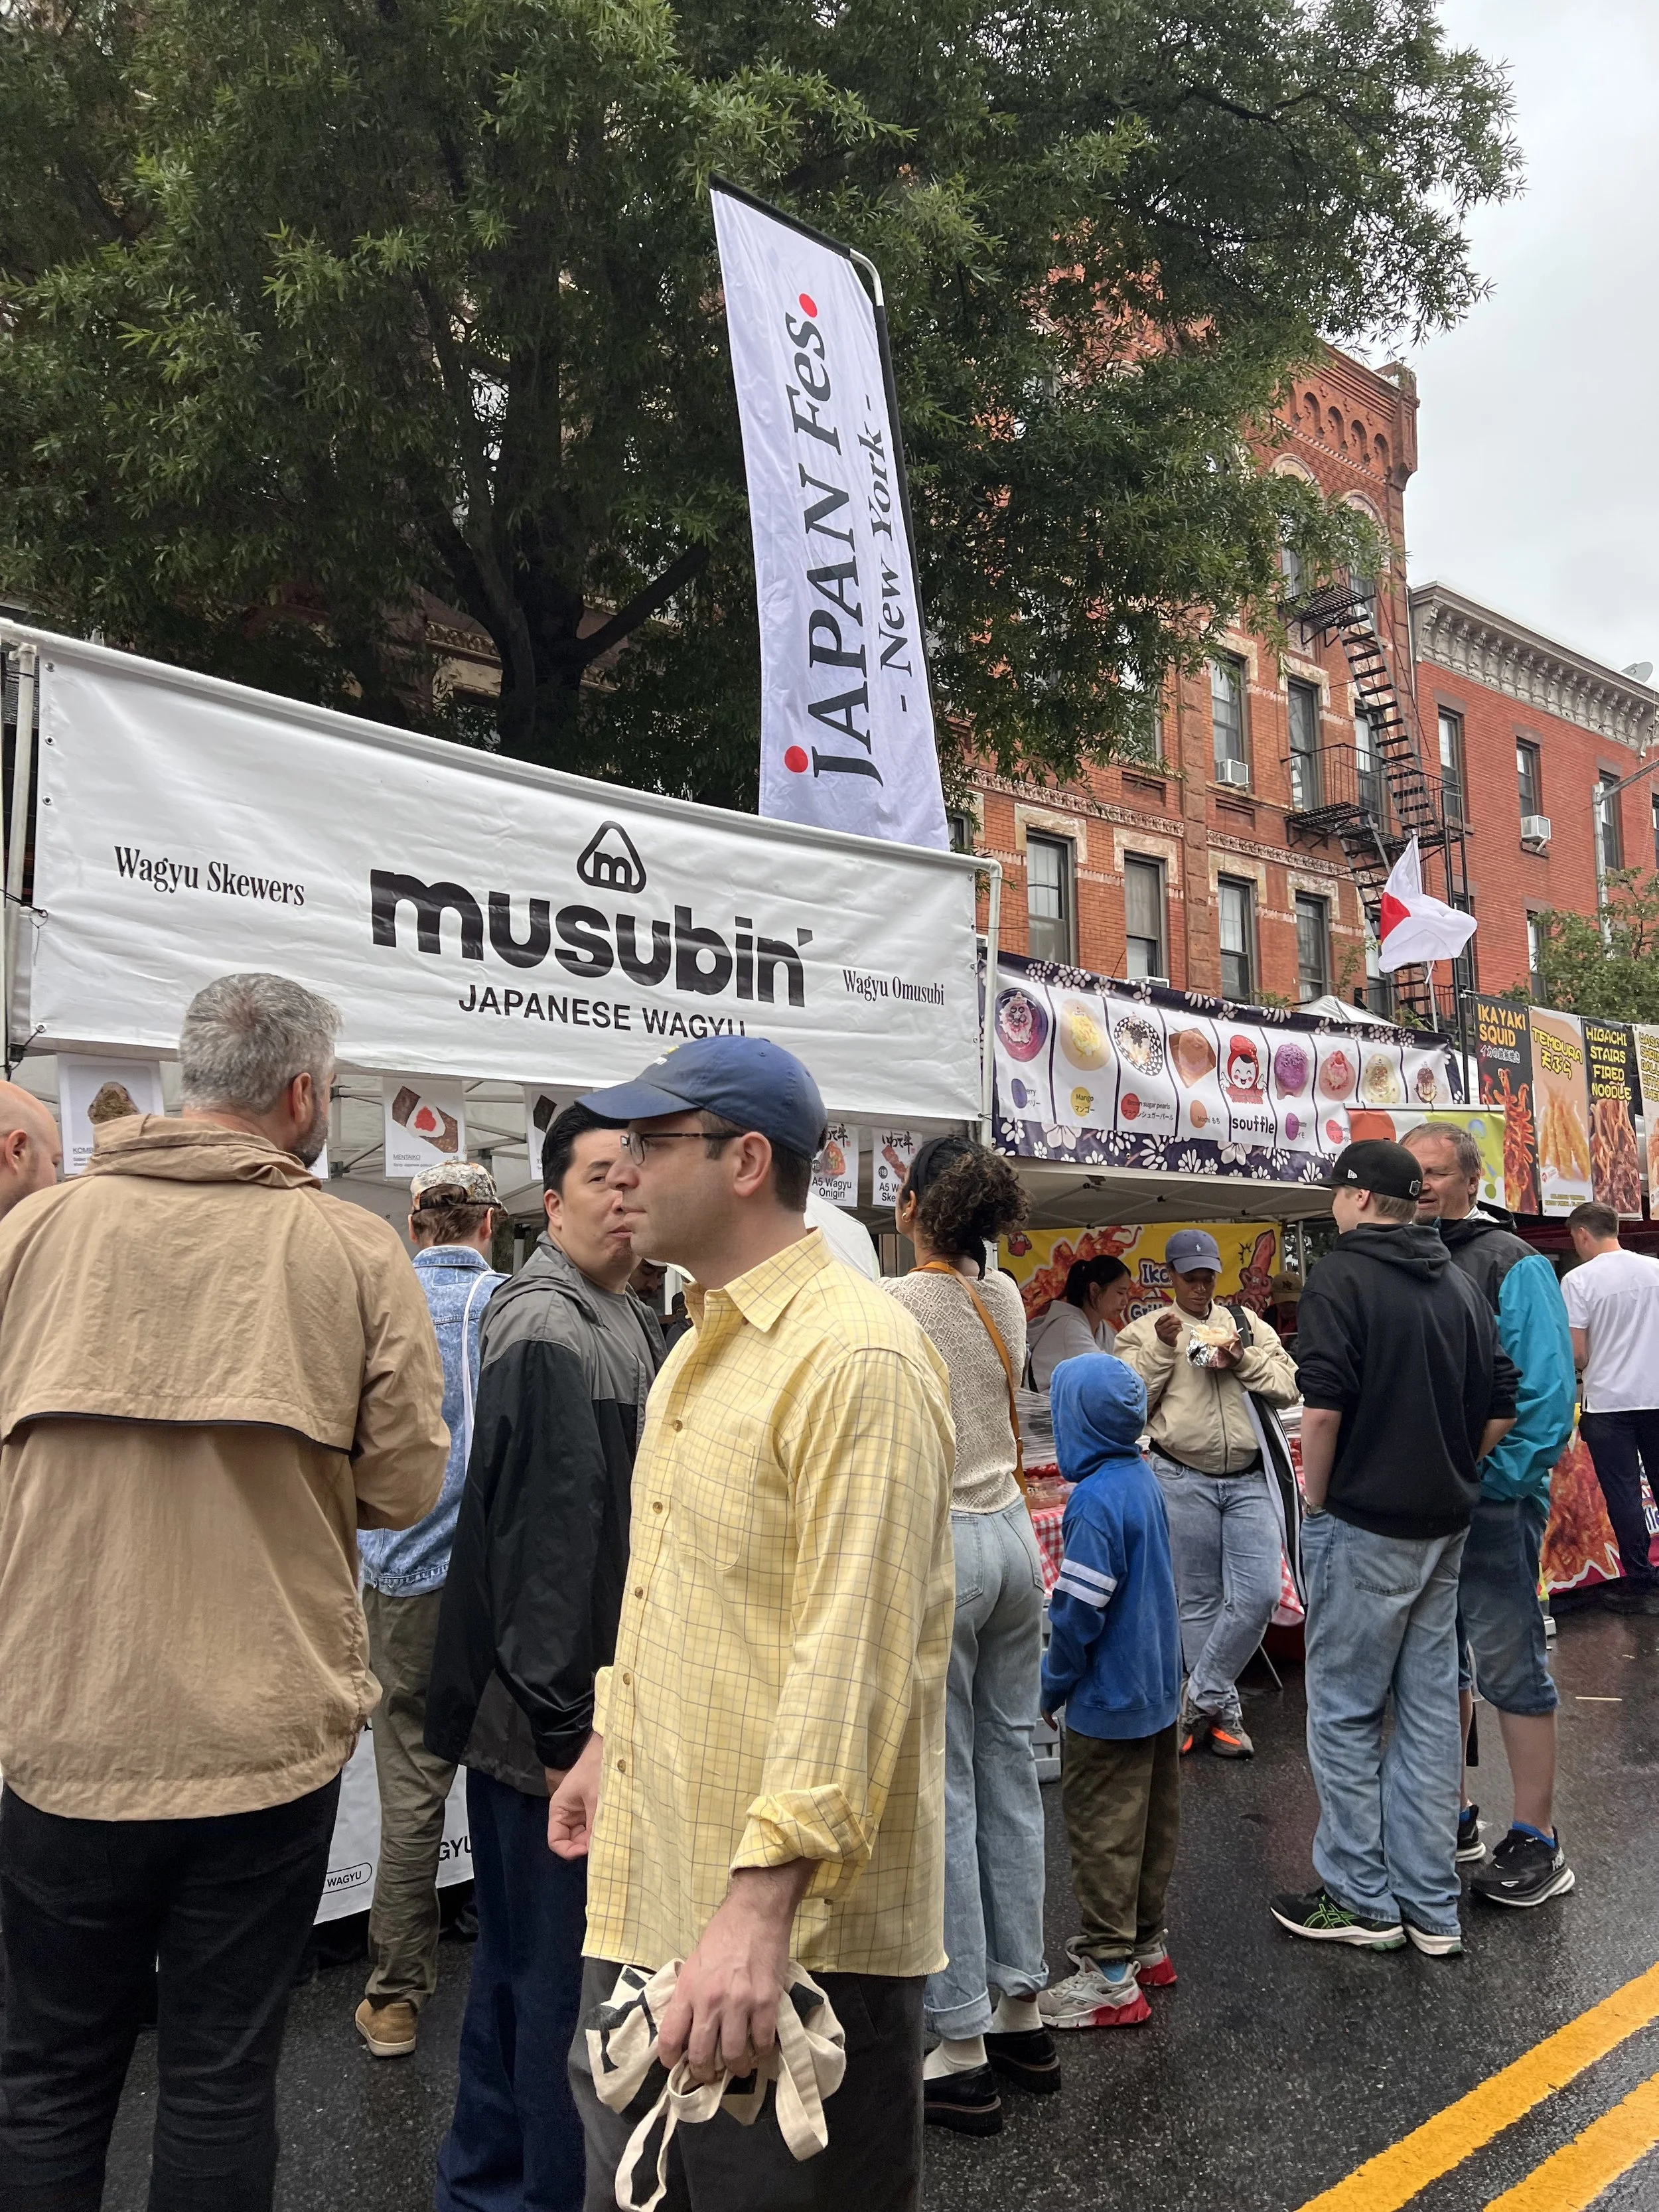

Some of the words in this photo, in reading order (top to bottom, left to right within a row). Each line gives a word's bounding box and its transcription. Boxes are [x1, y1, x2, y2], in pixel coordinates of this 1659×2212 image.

[784, 292, 843, 456] Fes.
[857, 421, 893, 542] York
[878, 552, 913, 678] New
[113, 846, 199, 893] Wagyu
[206, 861, 305, 907] Skewers
[842, 969, 889, 1004] Wagyu
[893, 974, 946, 1006] Omusubi
[459, 984, 632, 1031] JAPANESE
[642, 1007, 745, 1039] WAGYU
[1477, 1003, 1526, 1031] IKAYAKI
[1479, 1023, 1516, 1047] SQUID
[1585, 1026, 1628, 1047] HIBACHI
[1638, 1031, 1659, 1049] WASA
[1541, 1047, 1573, 1080] 天ぷら
[1590, 1045, 1626, 1064] STAIRS
[1640, 1045, 1659, 1062] SHRI
[1593, 1064, 1624, 1082] FIRED
[1076, 1093, 1094, 1103] Mango
[1591, 1082, 1632, 1101] NOODLE
[1075, 1105, 1095, 1114] マンゴー
[1232, 1115, 1275, 1134] souffle
[812, 1176, 824, 1187] A5
[825, 1177, 852, 1191] Wagyu
[879, 1182, 890, 1192] A5
[439, 1835, 472, 1861] GYU
[327, 1870, 362, 1887] WAGYU
